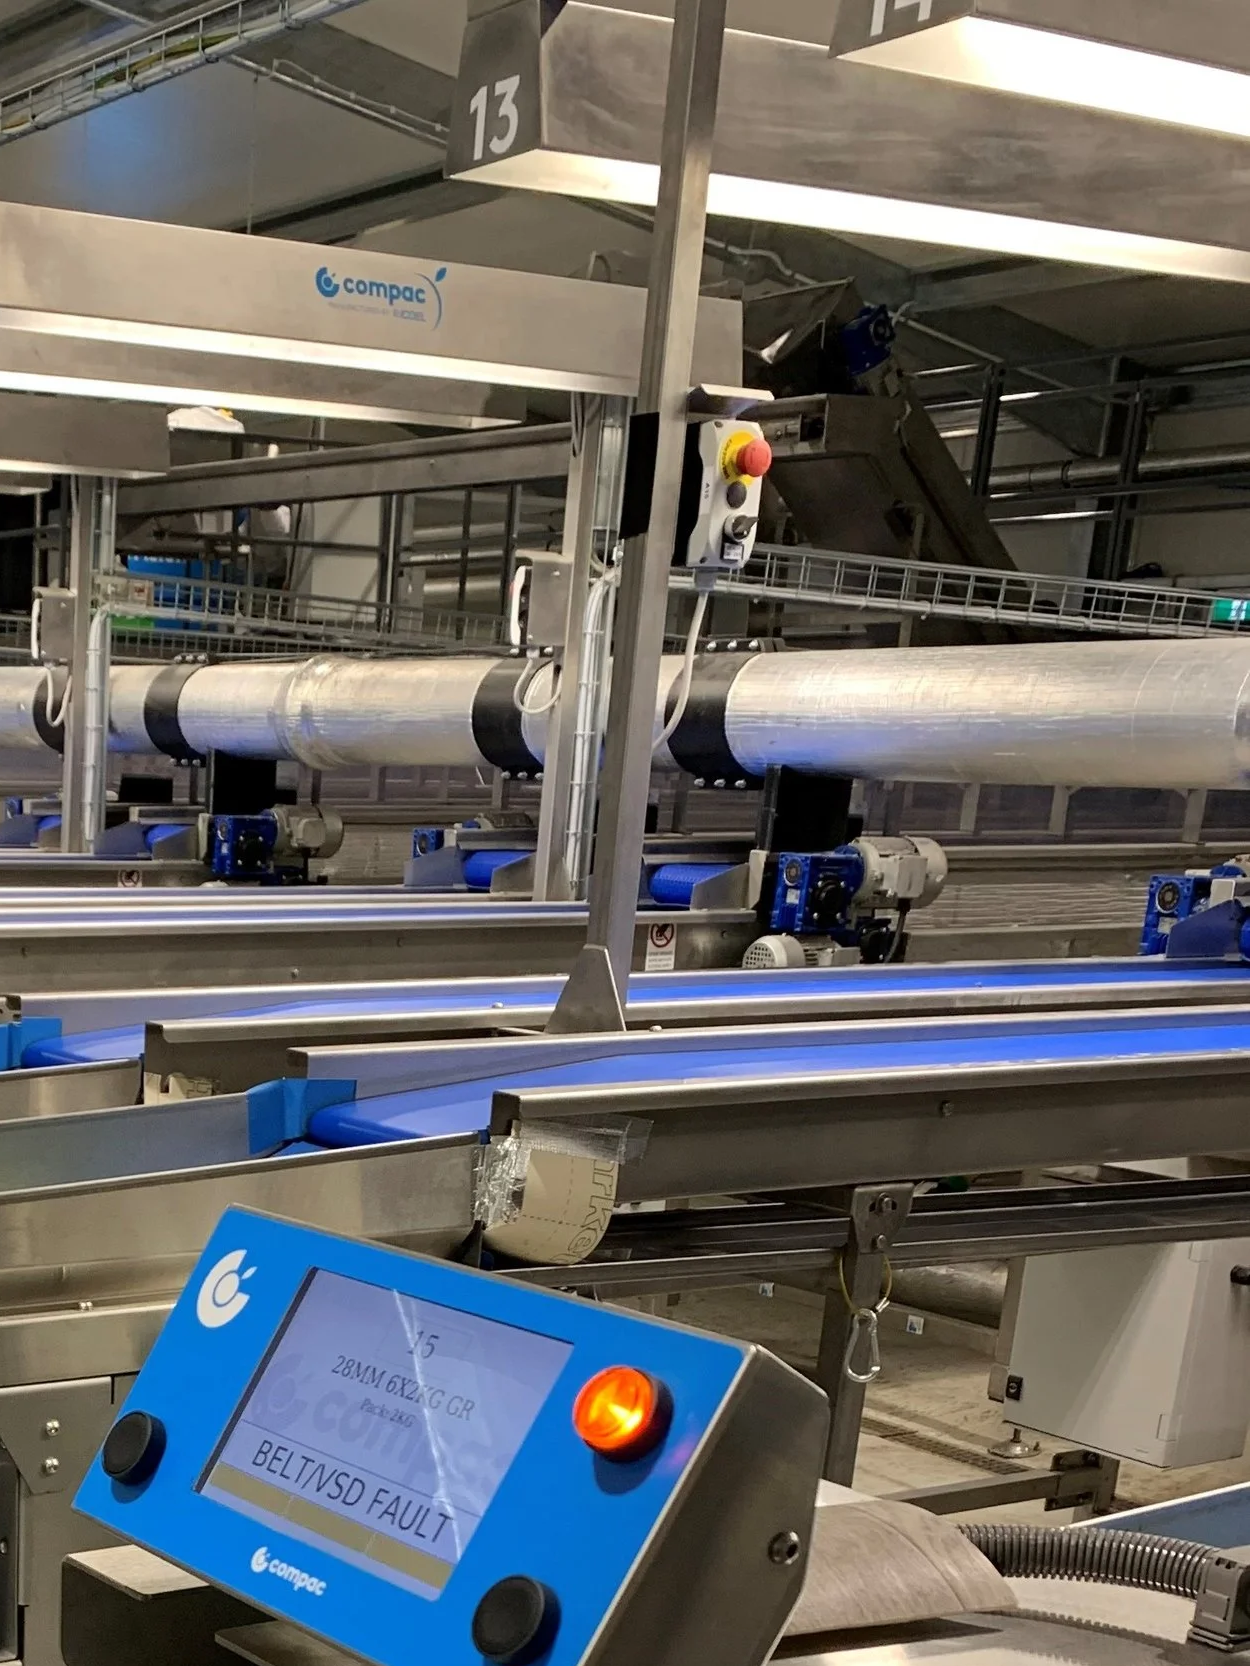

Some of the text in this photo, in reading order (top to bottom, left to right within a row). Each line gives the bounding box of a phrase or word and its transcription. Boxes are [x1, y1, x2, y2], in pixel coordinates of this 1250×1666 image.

[469, 74, 521, 161] 13
[342, 277, 427, 306] compac
[406, 1330, 440, 1360] 15
[331, 1355, 476, 1421] 28MM 6X2KG GR
[251, 1439, 454, 1543] BELT/VSD FAULT
[268, 1557, 327, 1596] compac
